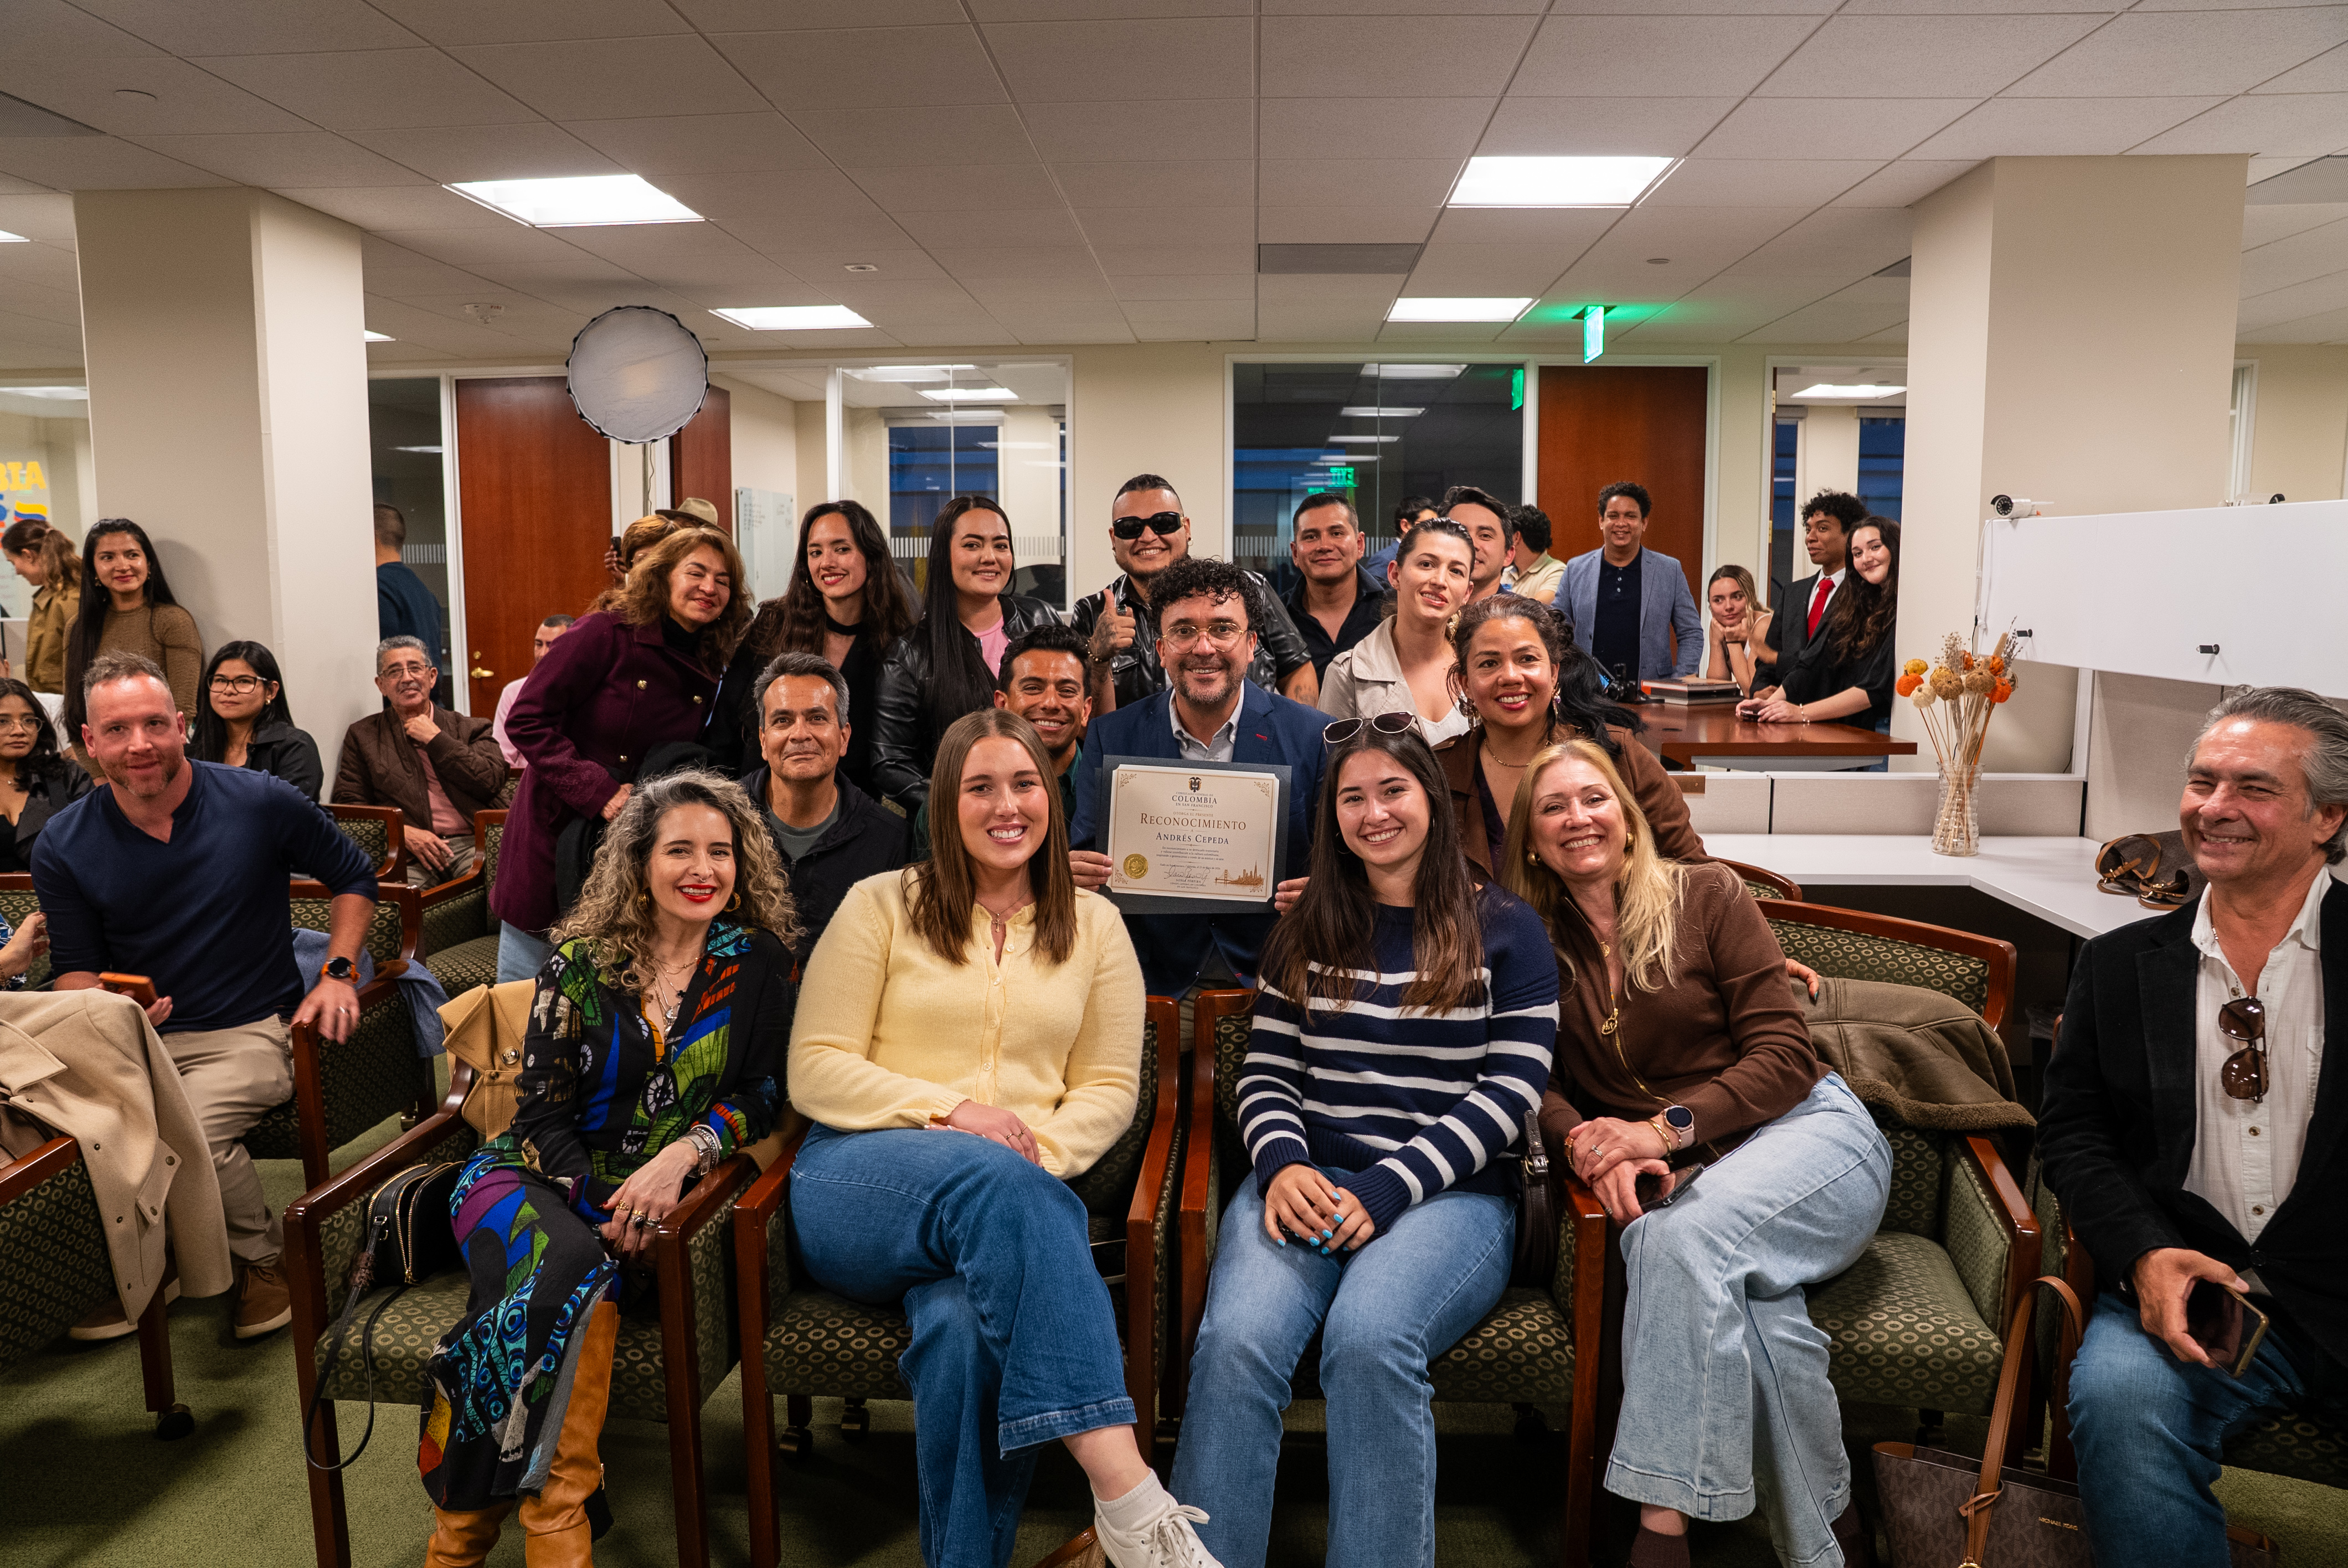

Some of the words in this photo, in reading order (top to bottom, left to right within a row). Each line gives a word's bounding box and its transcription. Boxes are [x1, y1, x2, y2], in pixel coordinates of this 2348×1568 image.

[1172, 795, 1217, 804] COLOMBIA
[1140, 813, 1247, 831] RECONOCIMIENTO
[1156, 832, 1192, 842] ANDRÉS
[1195, 834, 1229, 844] CEPEDA
